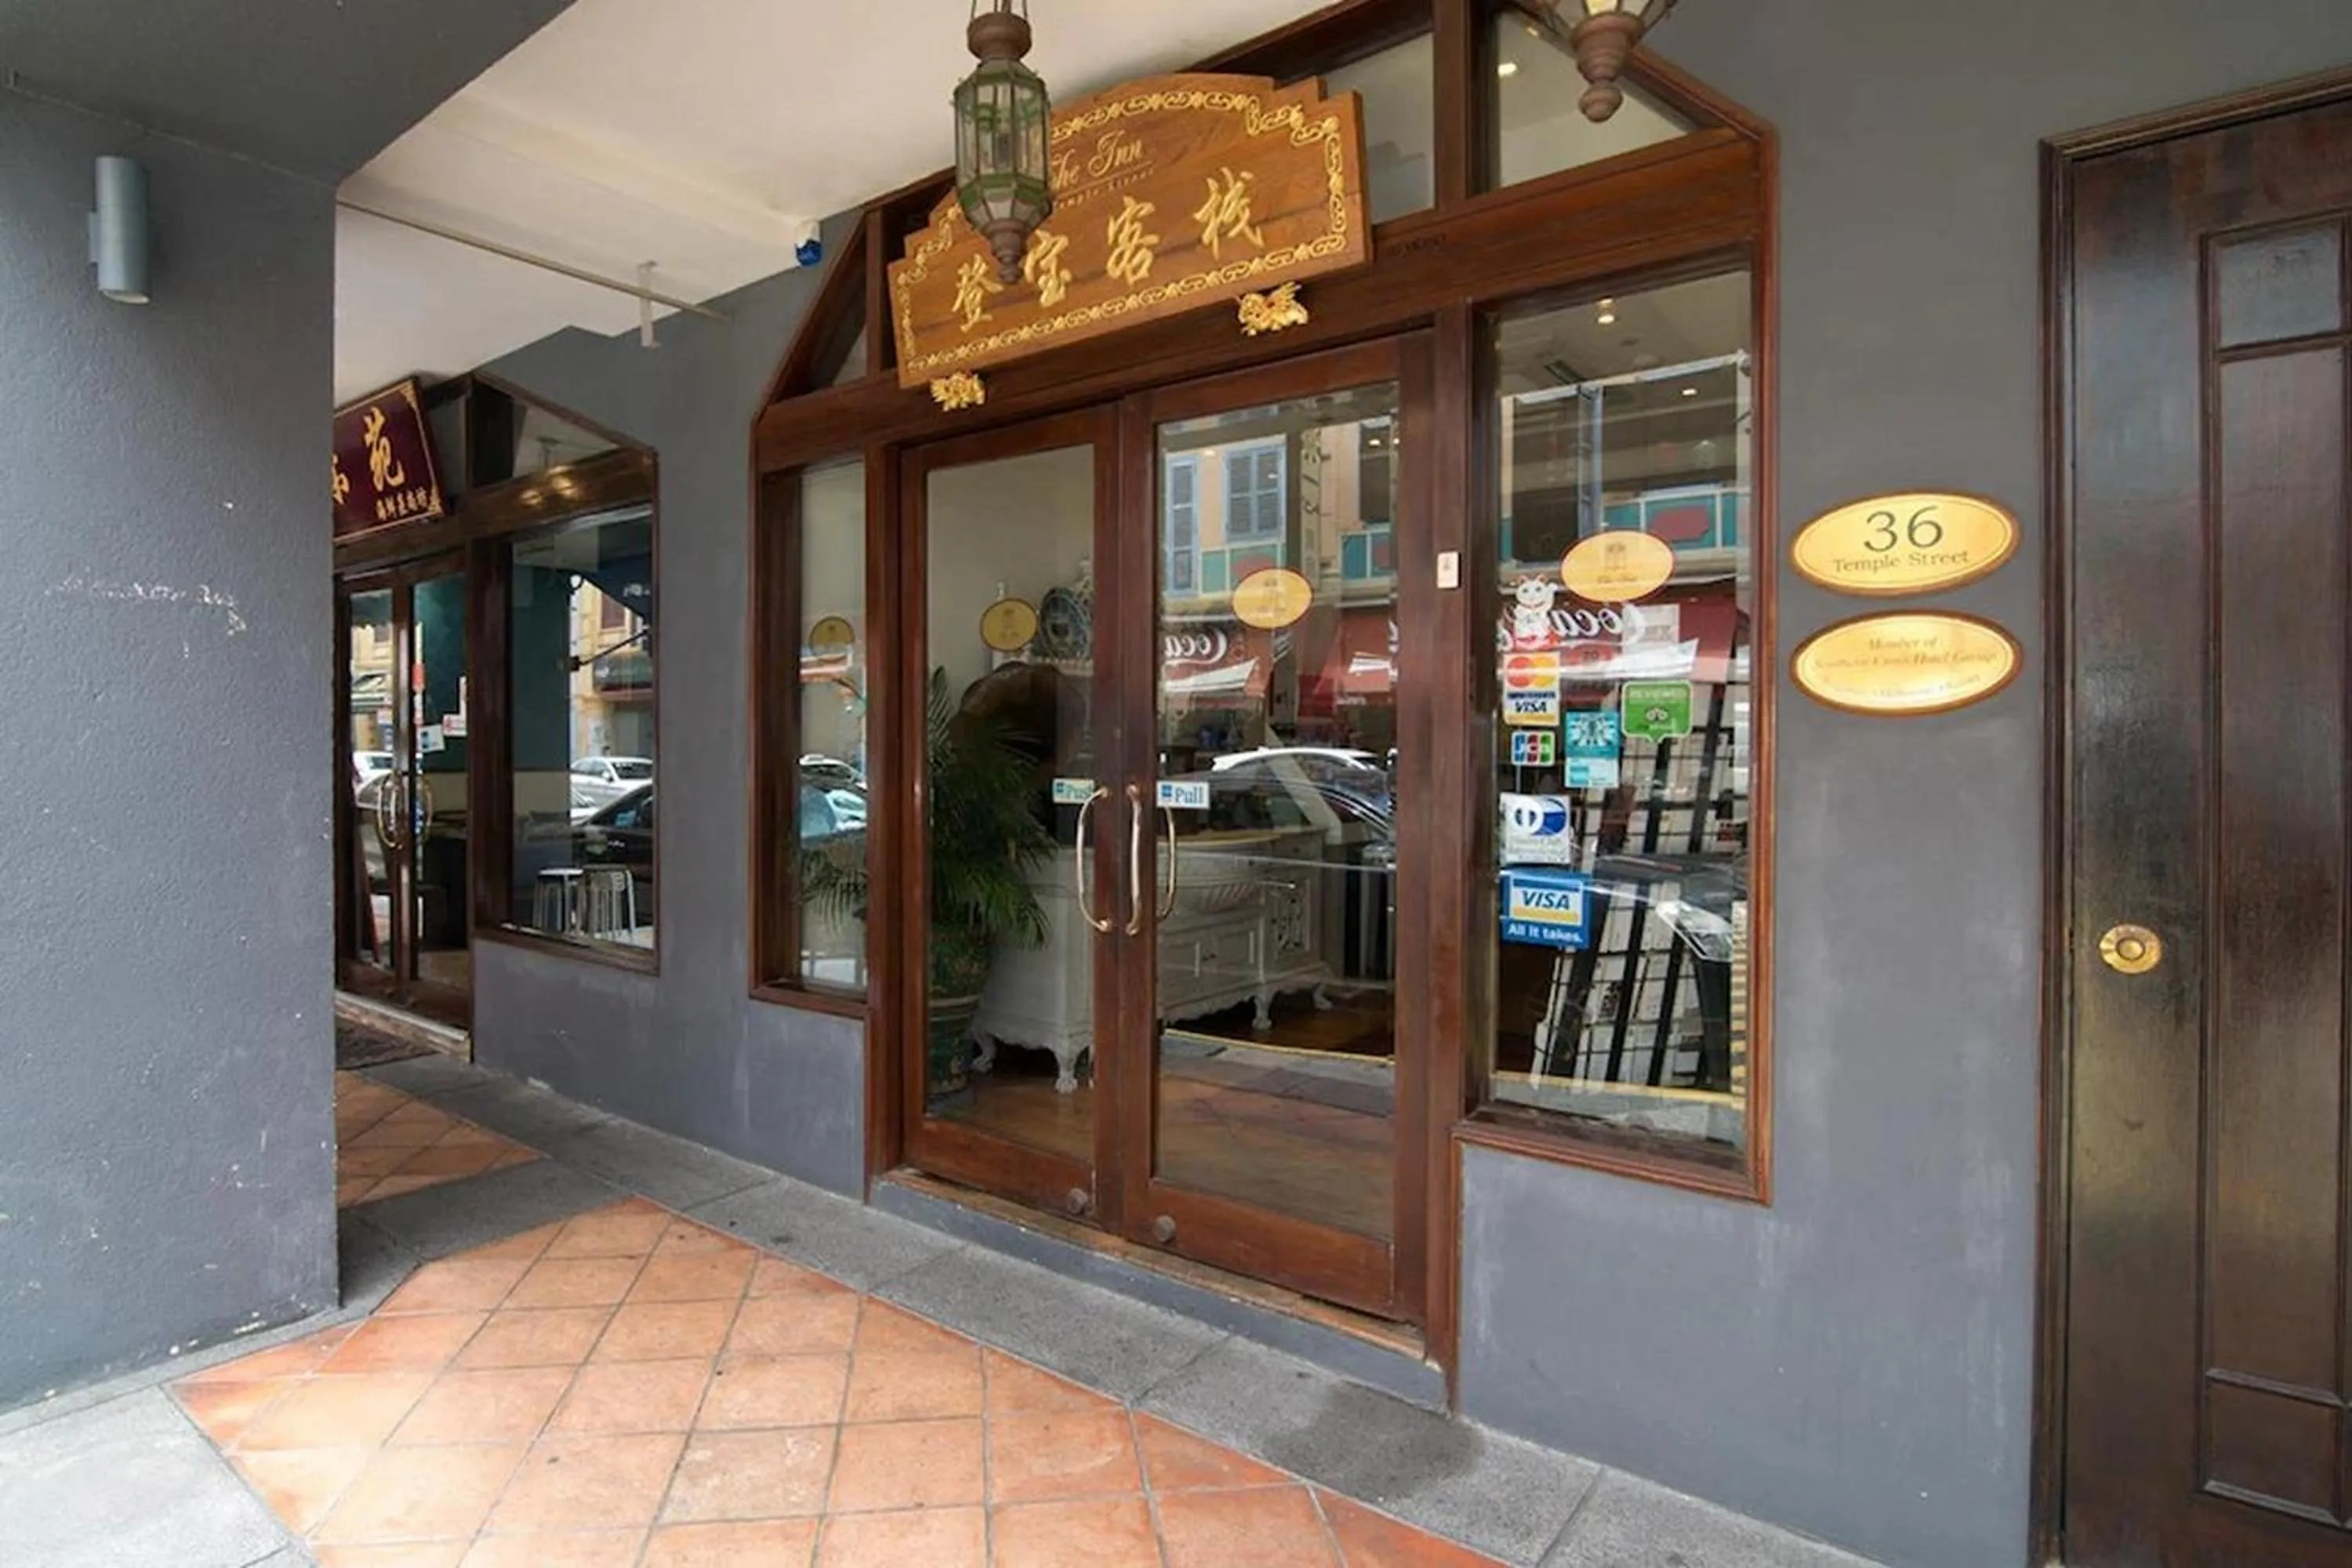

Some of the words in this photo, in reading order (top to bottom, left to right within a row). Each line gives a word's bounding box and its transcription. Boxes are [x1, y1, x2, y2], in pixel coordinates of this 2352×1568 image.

[1087, 129, 1143, 178] Inn
[1863, 505, 1944, 553] 36
[1832, 557, 1900, 574] Temple
[1907, 550, 1969, 567] Street
[1515, 701, 1547, 713] VISA
[1175, 786, 1205, 804] Pull
[1522, 890, 1570, 910] VISA
[1508, 924, 1526, 937] All
[1530, 924, 1541, 938] it
